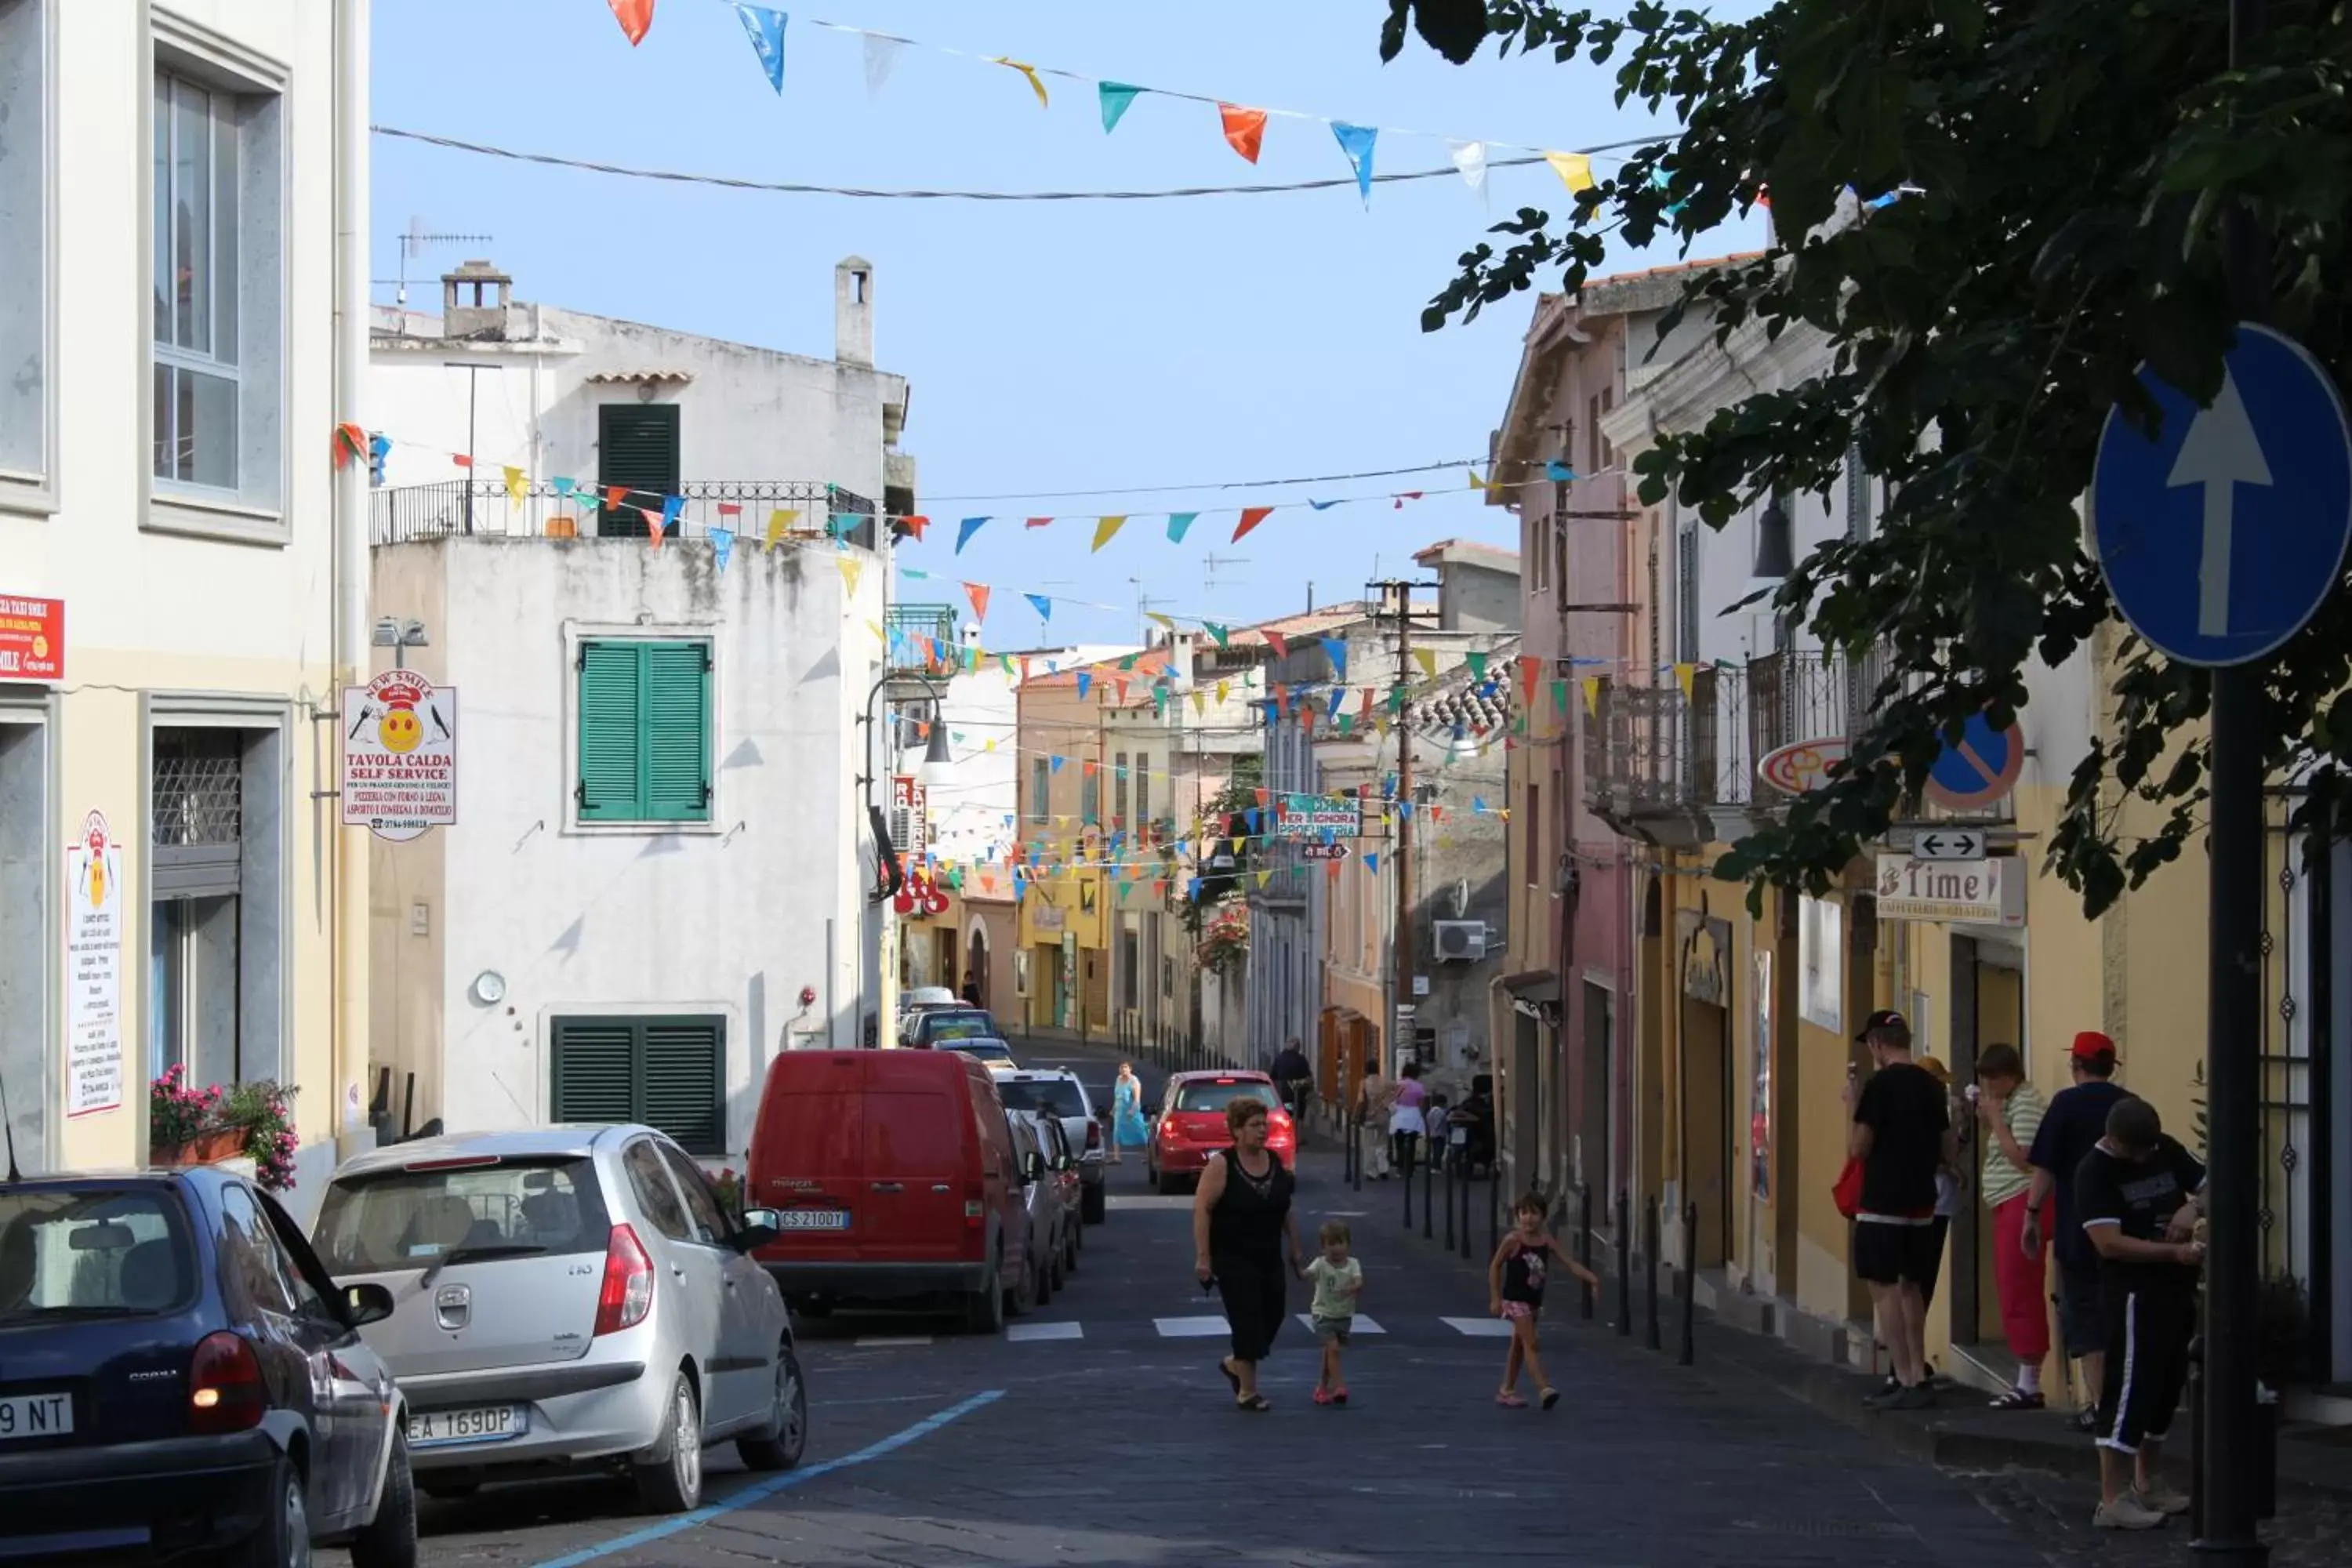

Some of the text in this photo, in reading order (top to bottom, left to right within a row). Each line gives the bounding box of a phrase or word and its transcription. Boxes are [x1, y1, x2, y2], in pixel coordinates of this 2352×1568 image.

[365, 673, 390, 699] NEW
[396, 671, 434, 699] SMILE
[347, 753, 452, 767] TAVOLA CALDA
[350, 768, 448, 780] SELF SERVICE
[354, 792, 382, 802] PIZZERIA
[383, 792, 397, 802] CON
[397, 792, 419, 802] FORNO
[425, 792, 446, 803] LEGNA
[347, 804, 375, 815] ASPORTO
[380, 804, 412, 815] CONSEGNA
[419, 804, 452, 815] DOMICILIO
[1904, 861, 1979, 900] Time
[782, 1211, 799, 1225] CS
[28, 1398, 64, 1432] NT
[408, 1408, 511, 1439] EA 169DP
